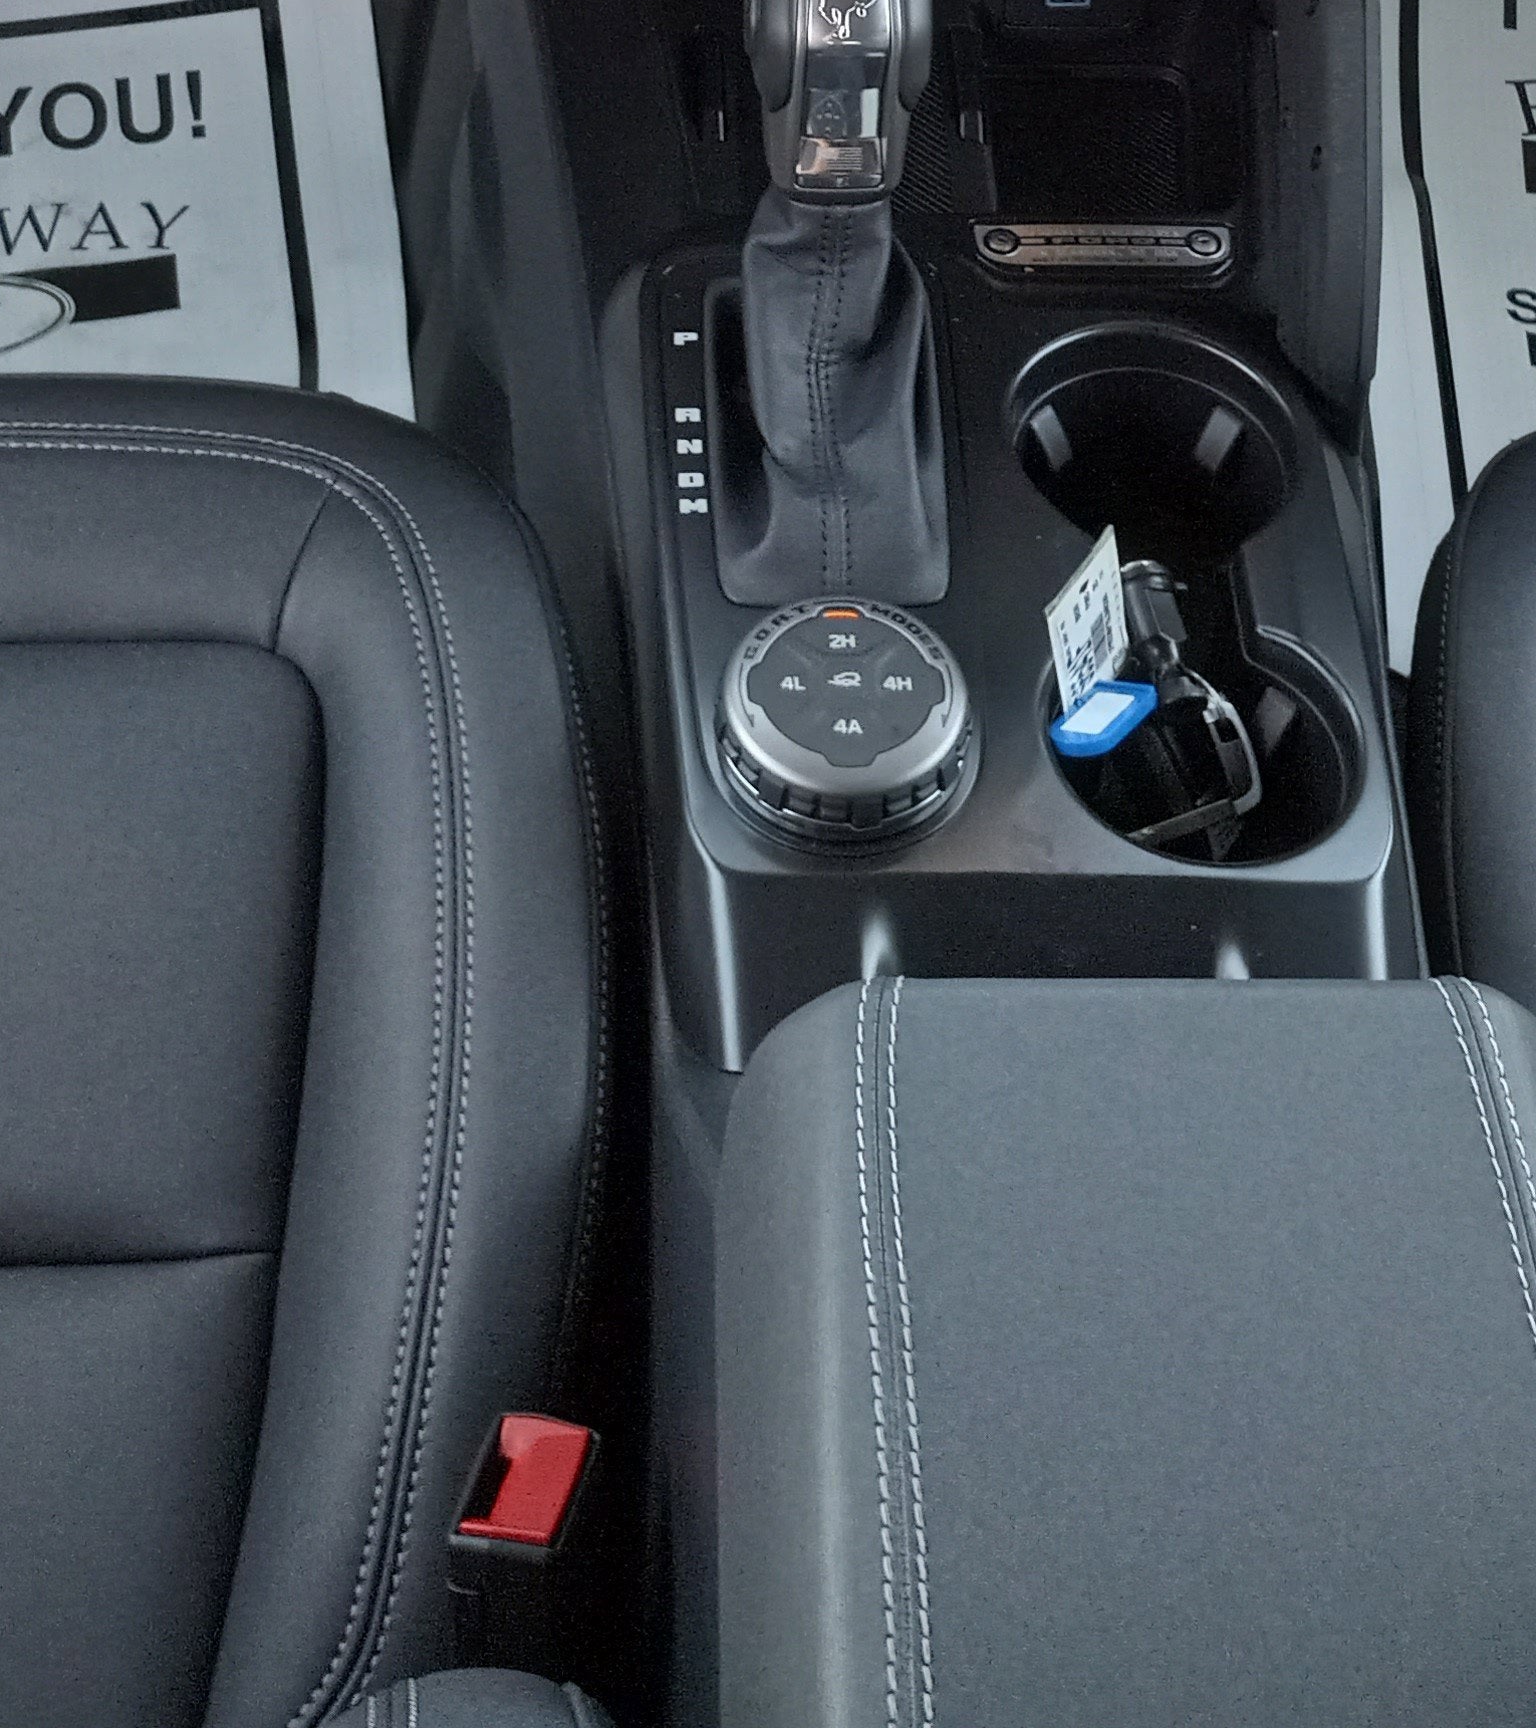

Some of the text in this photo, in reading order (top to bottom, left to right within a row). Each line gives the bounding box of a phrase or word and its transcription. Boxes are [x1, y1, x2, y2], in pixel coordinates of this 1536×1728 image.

[673, 331, 699, 345] P
[676, 440, 703, 454] N
[678, 473, 705, 488] D
[678, 499, 708, 514] M
[870, 603, 945, 660] MODES
[828, 634, 856, 649] 2H
[780, 676, 806, 691] 4L
[883, 675, 913, 691] 4H
[833, 719, 863, 734] 4A
